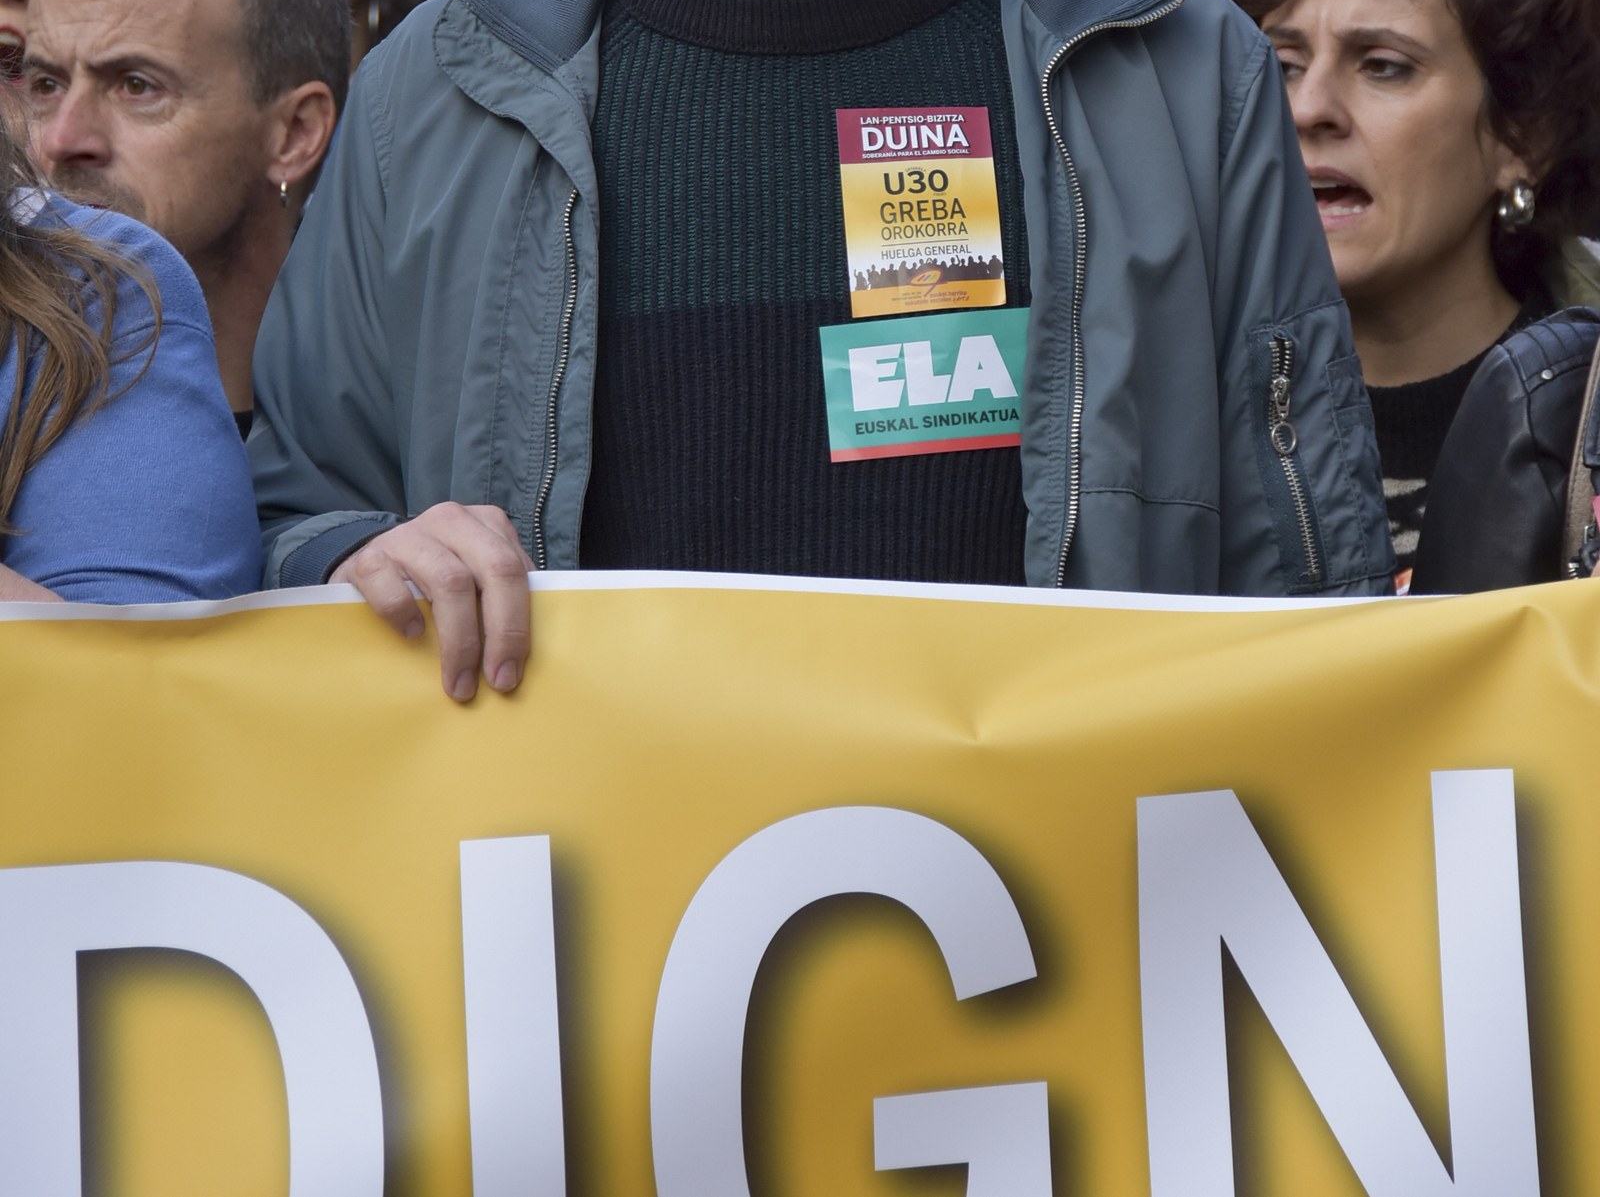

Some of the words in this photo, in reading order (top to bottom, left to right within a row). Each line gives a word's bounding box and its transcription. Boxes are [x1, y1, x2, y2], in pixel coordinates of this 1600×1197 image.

[860, 114, 965, 125] LAN-PENTSIO-BIZITZA
[861, 124, 969, 152] DUINA
[862, 151, 897, 159] SOBERANÍA
[883, 169, 949, 195] U30
[880, 198, 967, 224] GREBA
[881, 222, 969, 241] OROKORRA
[881, 248, 922, 260] HUELGA
[924, 244, 972, 256] GENERAL
[848, 335, 1018, 412] ELA
[855, 417, 919, 435] EUSKAL
[922, 408, 1020, 429] SINDIKATUA
[0, 767, 1541, 1197] DIGN
